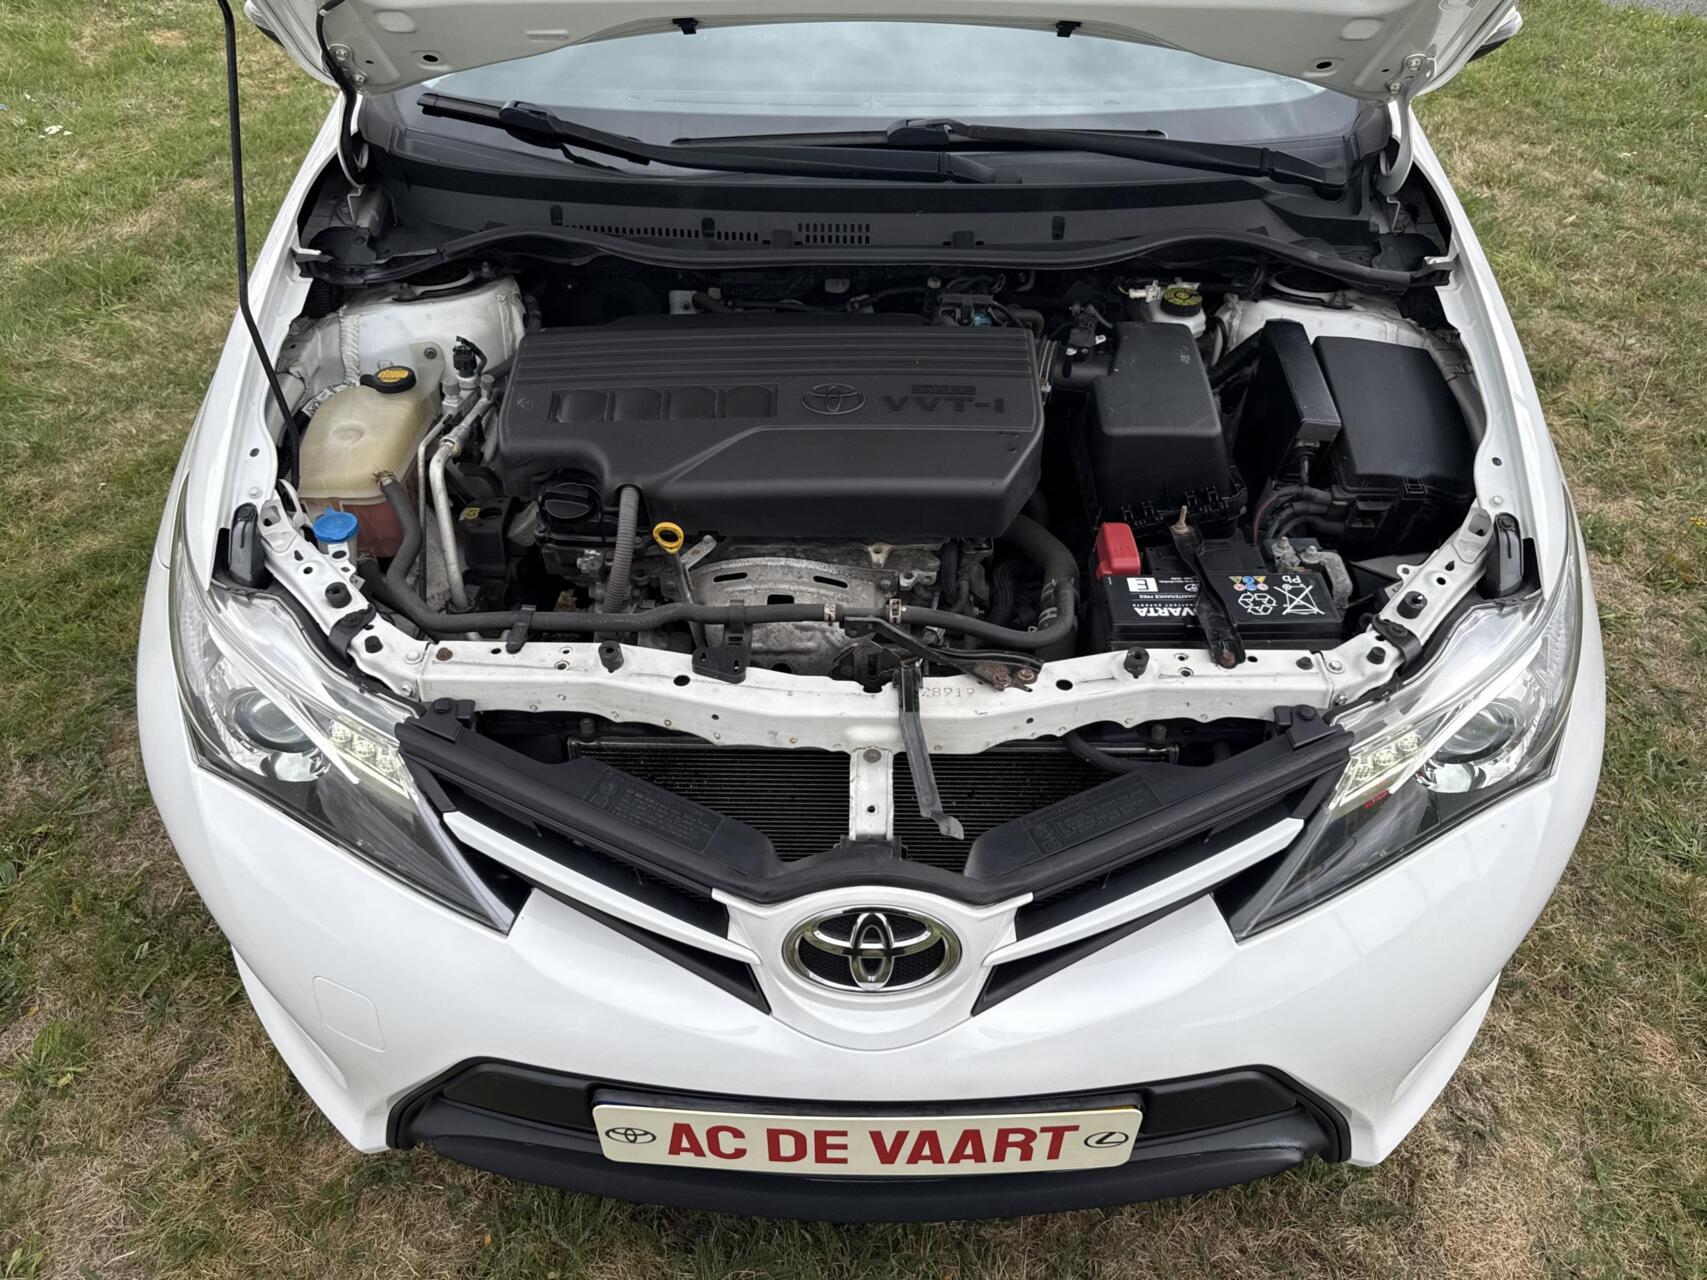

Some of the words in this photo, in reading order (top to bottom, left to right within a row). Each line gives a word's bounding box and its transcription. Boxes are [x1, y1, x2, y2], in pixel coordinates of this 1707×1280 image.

[1282, 575, 1302, 584] Pb
[1135, 607, 1196, 617] VARTA
[668, 1123, 748, 1160] AC
[766, 1128, 849, 1165] DE
[868, 1124, 1080, 1165] VAART
